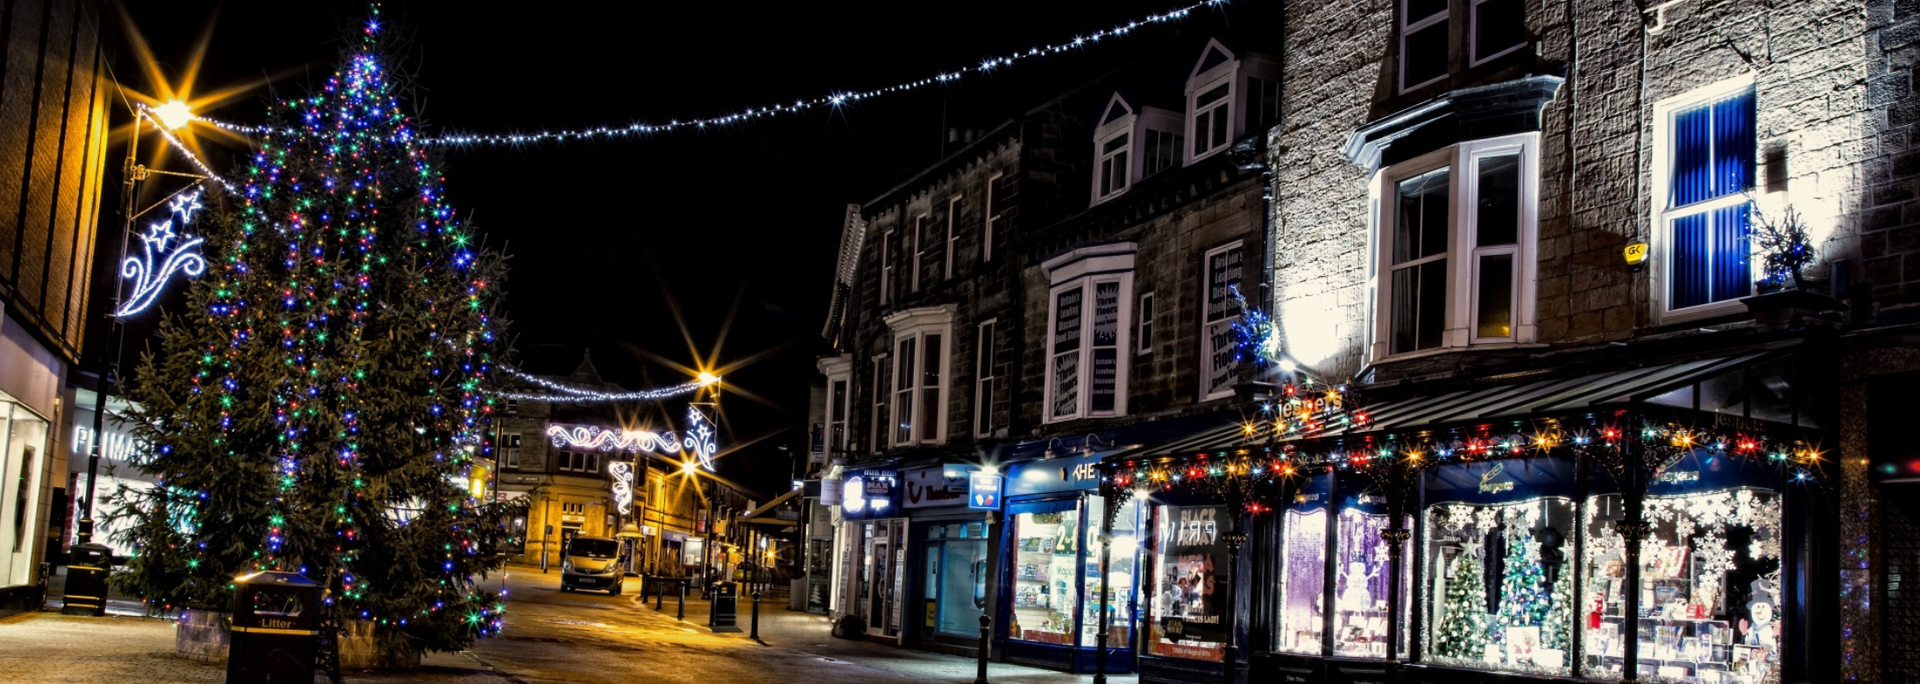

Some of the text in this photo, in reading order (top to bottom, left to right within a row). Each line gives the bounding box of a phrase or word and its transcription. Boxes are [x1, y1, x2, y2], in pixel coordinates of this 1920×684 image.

[1628, 245, 1641, 255] GK
[1214, 251, 1243, 270] Briain's
[1060, 292, 1080, 308] Britain's
[1097, 296, 1117, 307] Three
[1060, 305, 1079, 320] Leading
[1096, 306, 1118, 316] Floors
[1058, 363, 1076, 382] Three
[1060, 376, 1078, 396] Floors
[1181, 507, 1216, 527] BLACK
[262, 618, 292, 628] Litter
